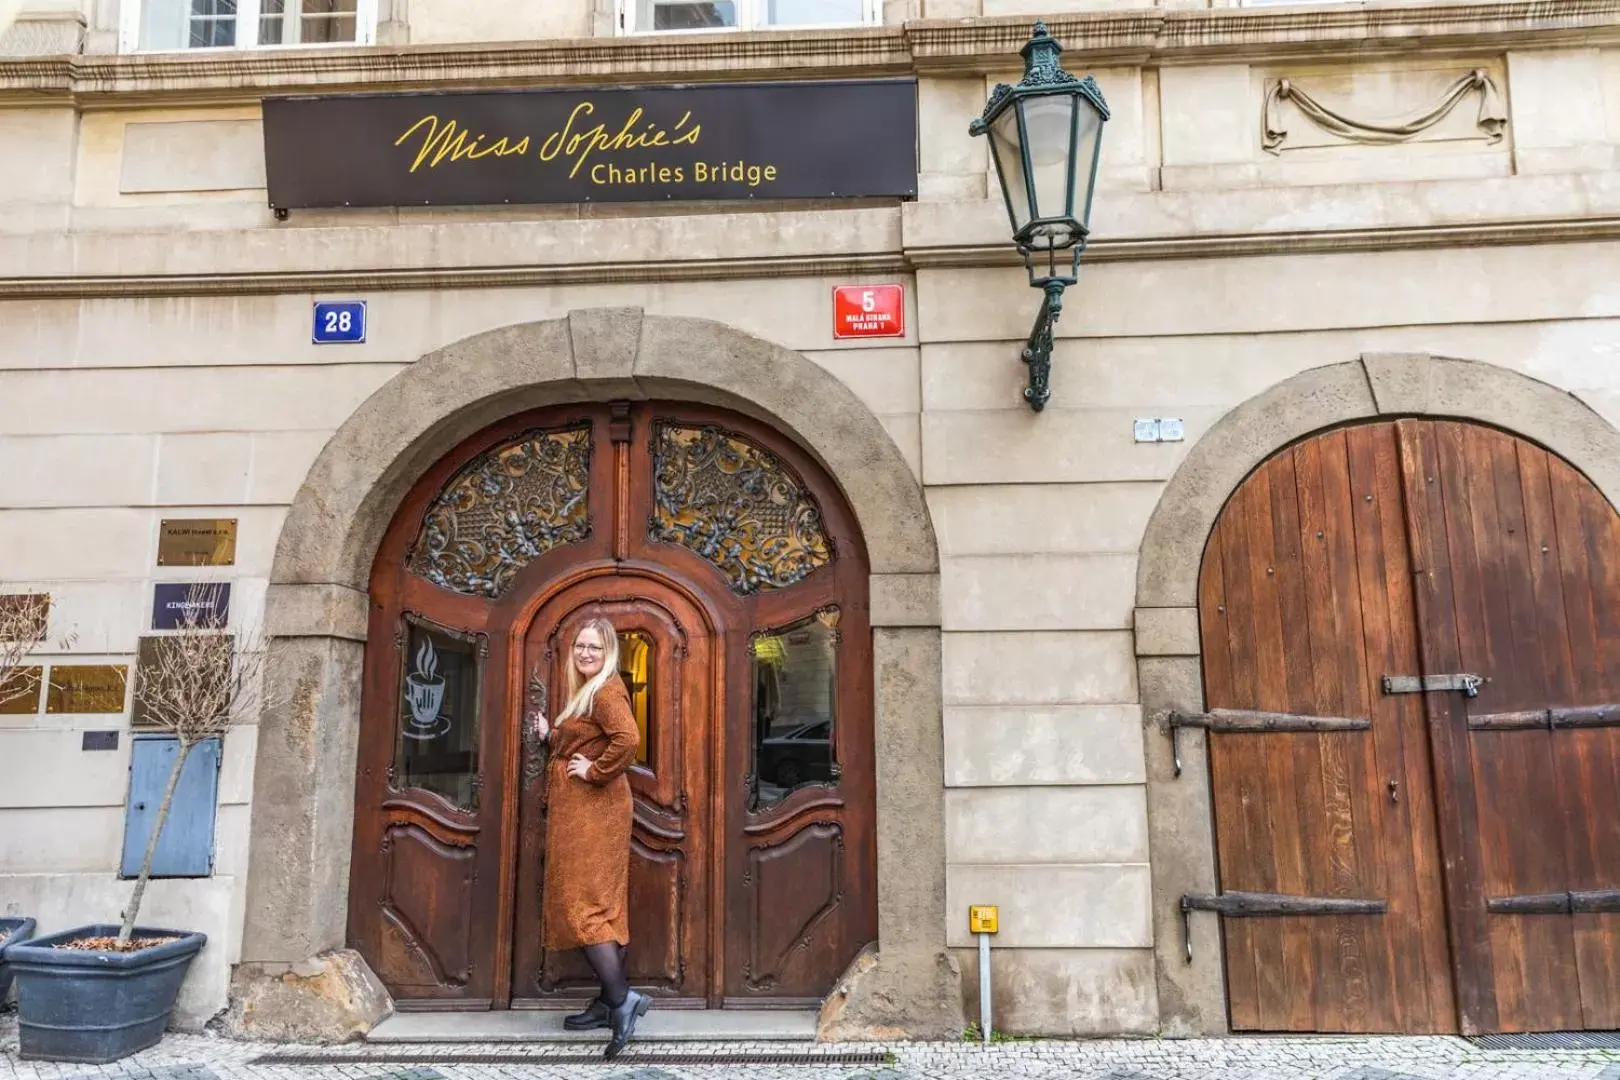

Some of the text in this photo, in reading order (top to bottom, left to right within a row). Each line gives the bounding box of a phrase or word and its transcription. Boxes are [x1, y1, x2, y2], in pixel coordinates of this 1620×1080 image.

[395, 101, 701, 180] Miss Sophie's
[591, 160, 777, 187] Charles Bridge
[862, 291, 875, 312] 5
[325, 311, 351, 332] 28
[846, 313, 864, 322] MALÁ
[853, 322, 885, 330] PRAHA 1
